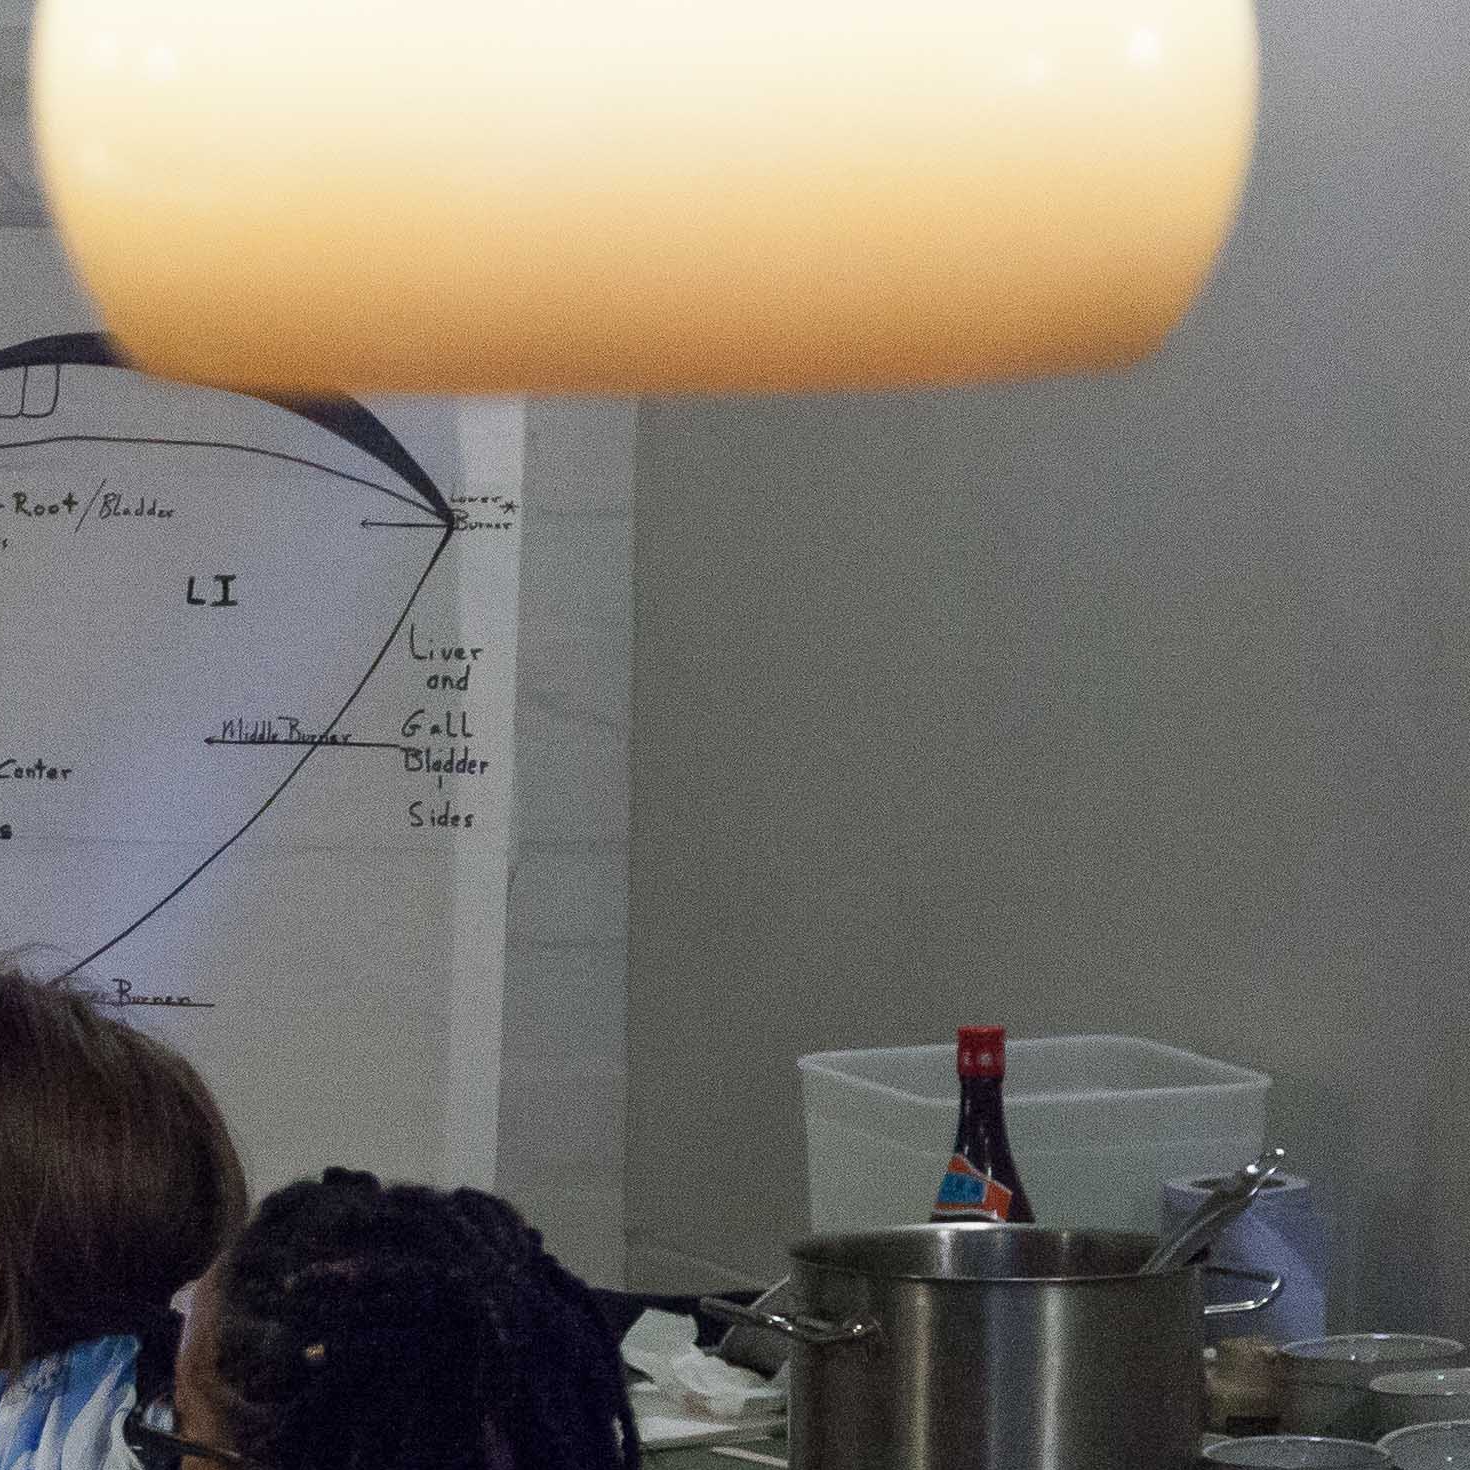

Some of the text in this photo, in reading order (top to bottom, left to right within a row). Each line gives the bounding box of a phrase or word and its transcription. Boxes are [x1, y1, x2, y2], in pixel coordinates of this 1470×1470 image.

[186, 574, 238, 607] LI
[410, 622, 484, 661] Liver
[427, 664, 471, 691] and
[401, 709, 473, 738] Gall
[404, 746, 489, 775] Bladder
[410, 800, 474, 828] Sides
